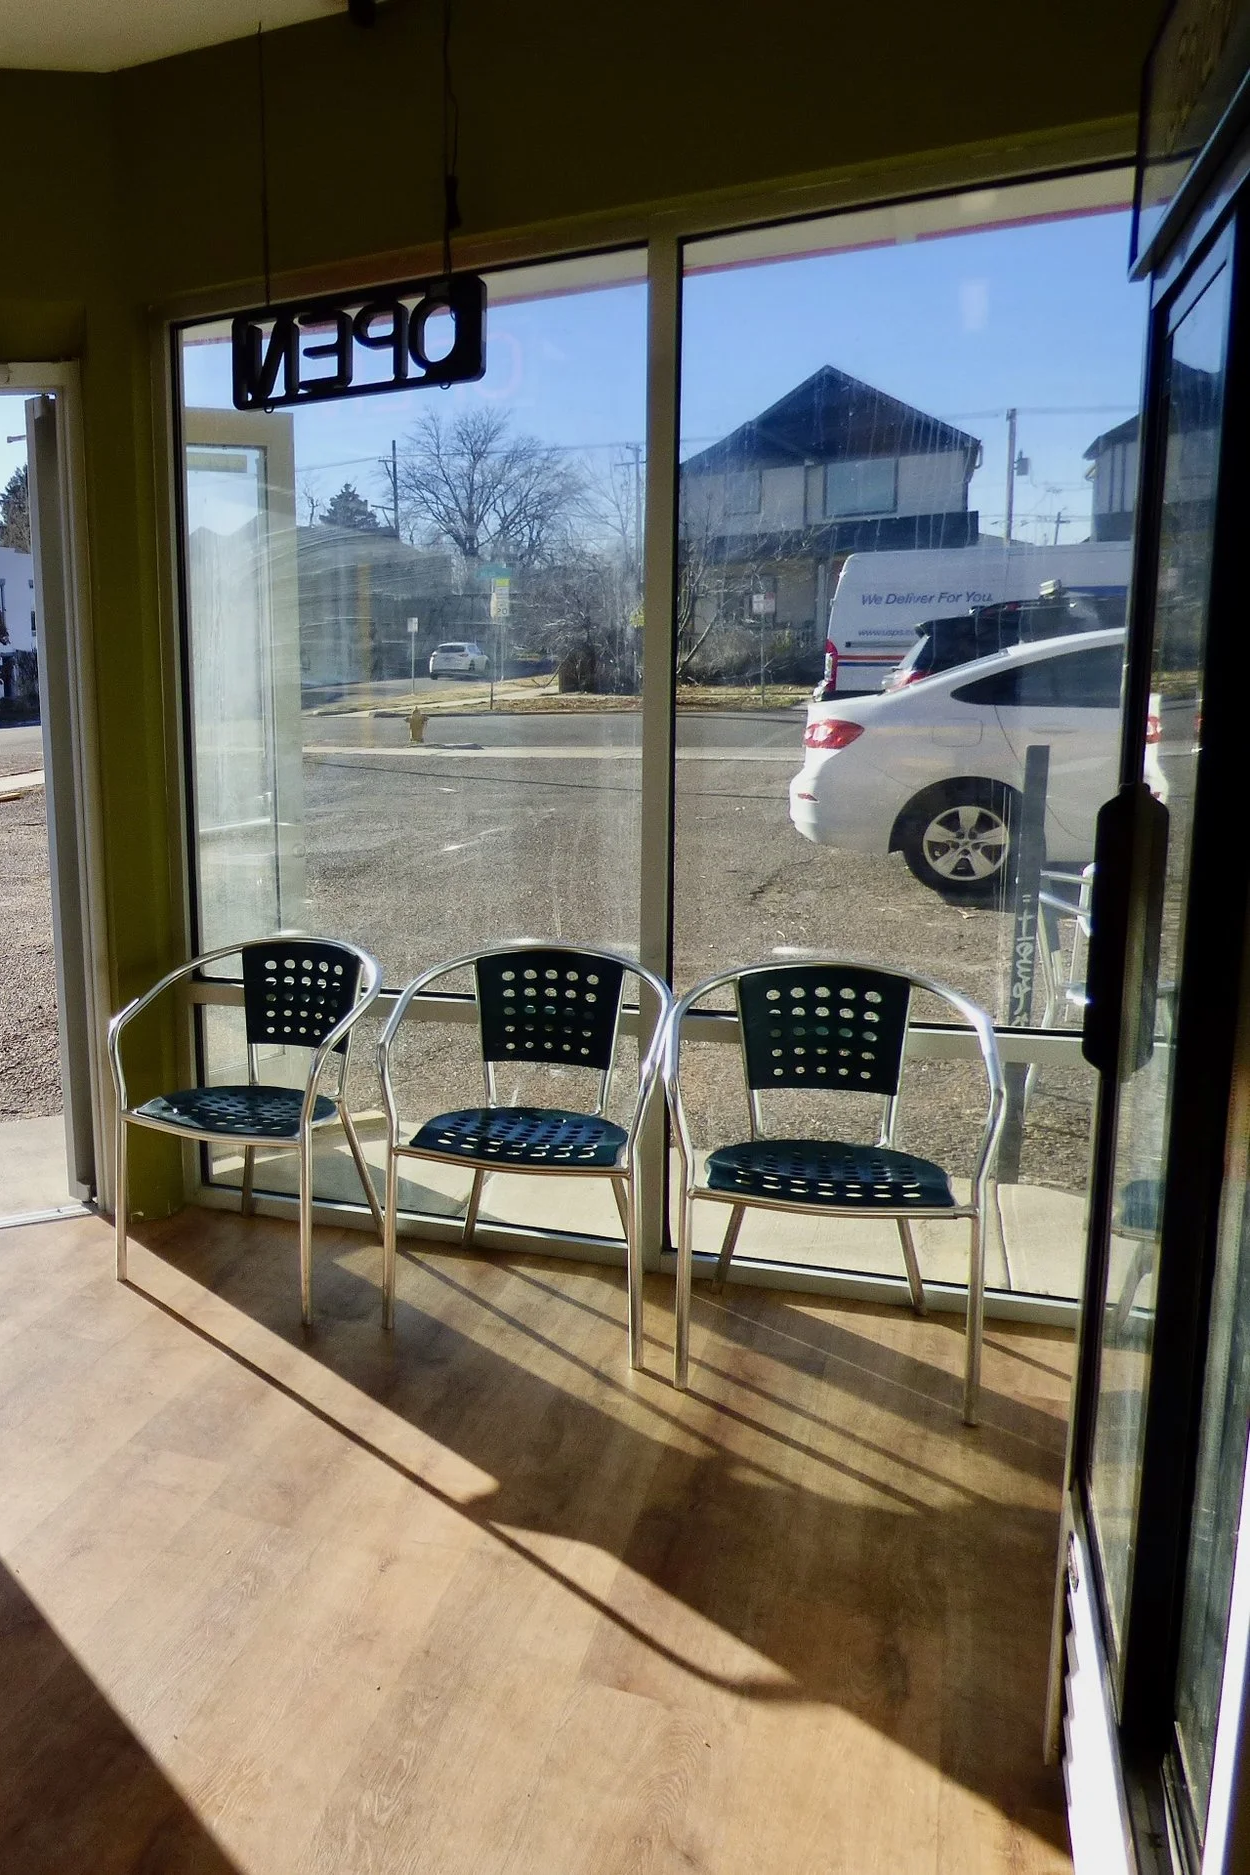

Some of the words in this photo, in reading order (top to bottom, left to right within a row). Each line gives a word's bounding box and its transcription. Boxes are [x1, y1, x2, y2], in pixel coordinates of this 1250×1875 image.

[861, 593, 883, 606] We
[885, 591, 936, 606] Deliver
[937, 591, 963, 604] For
